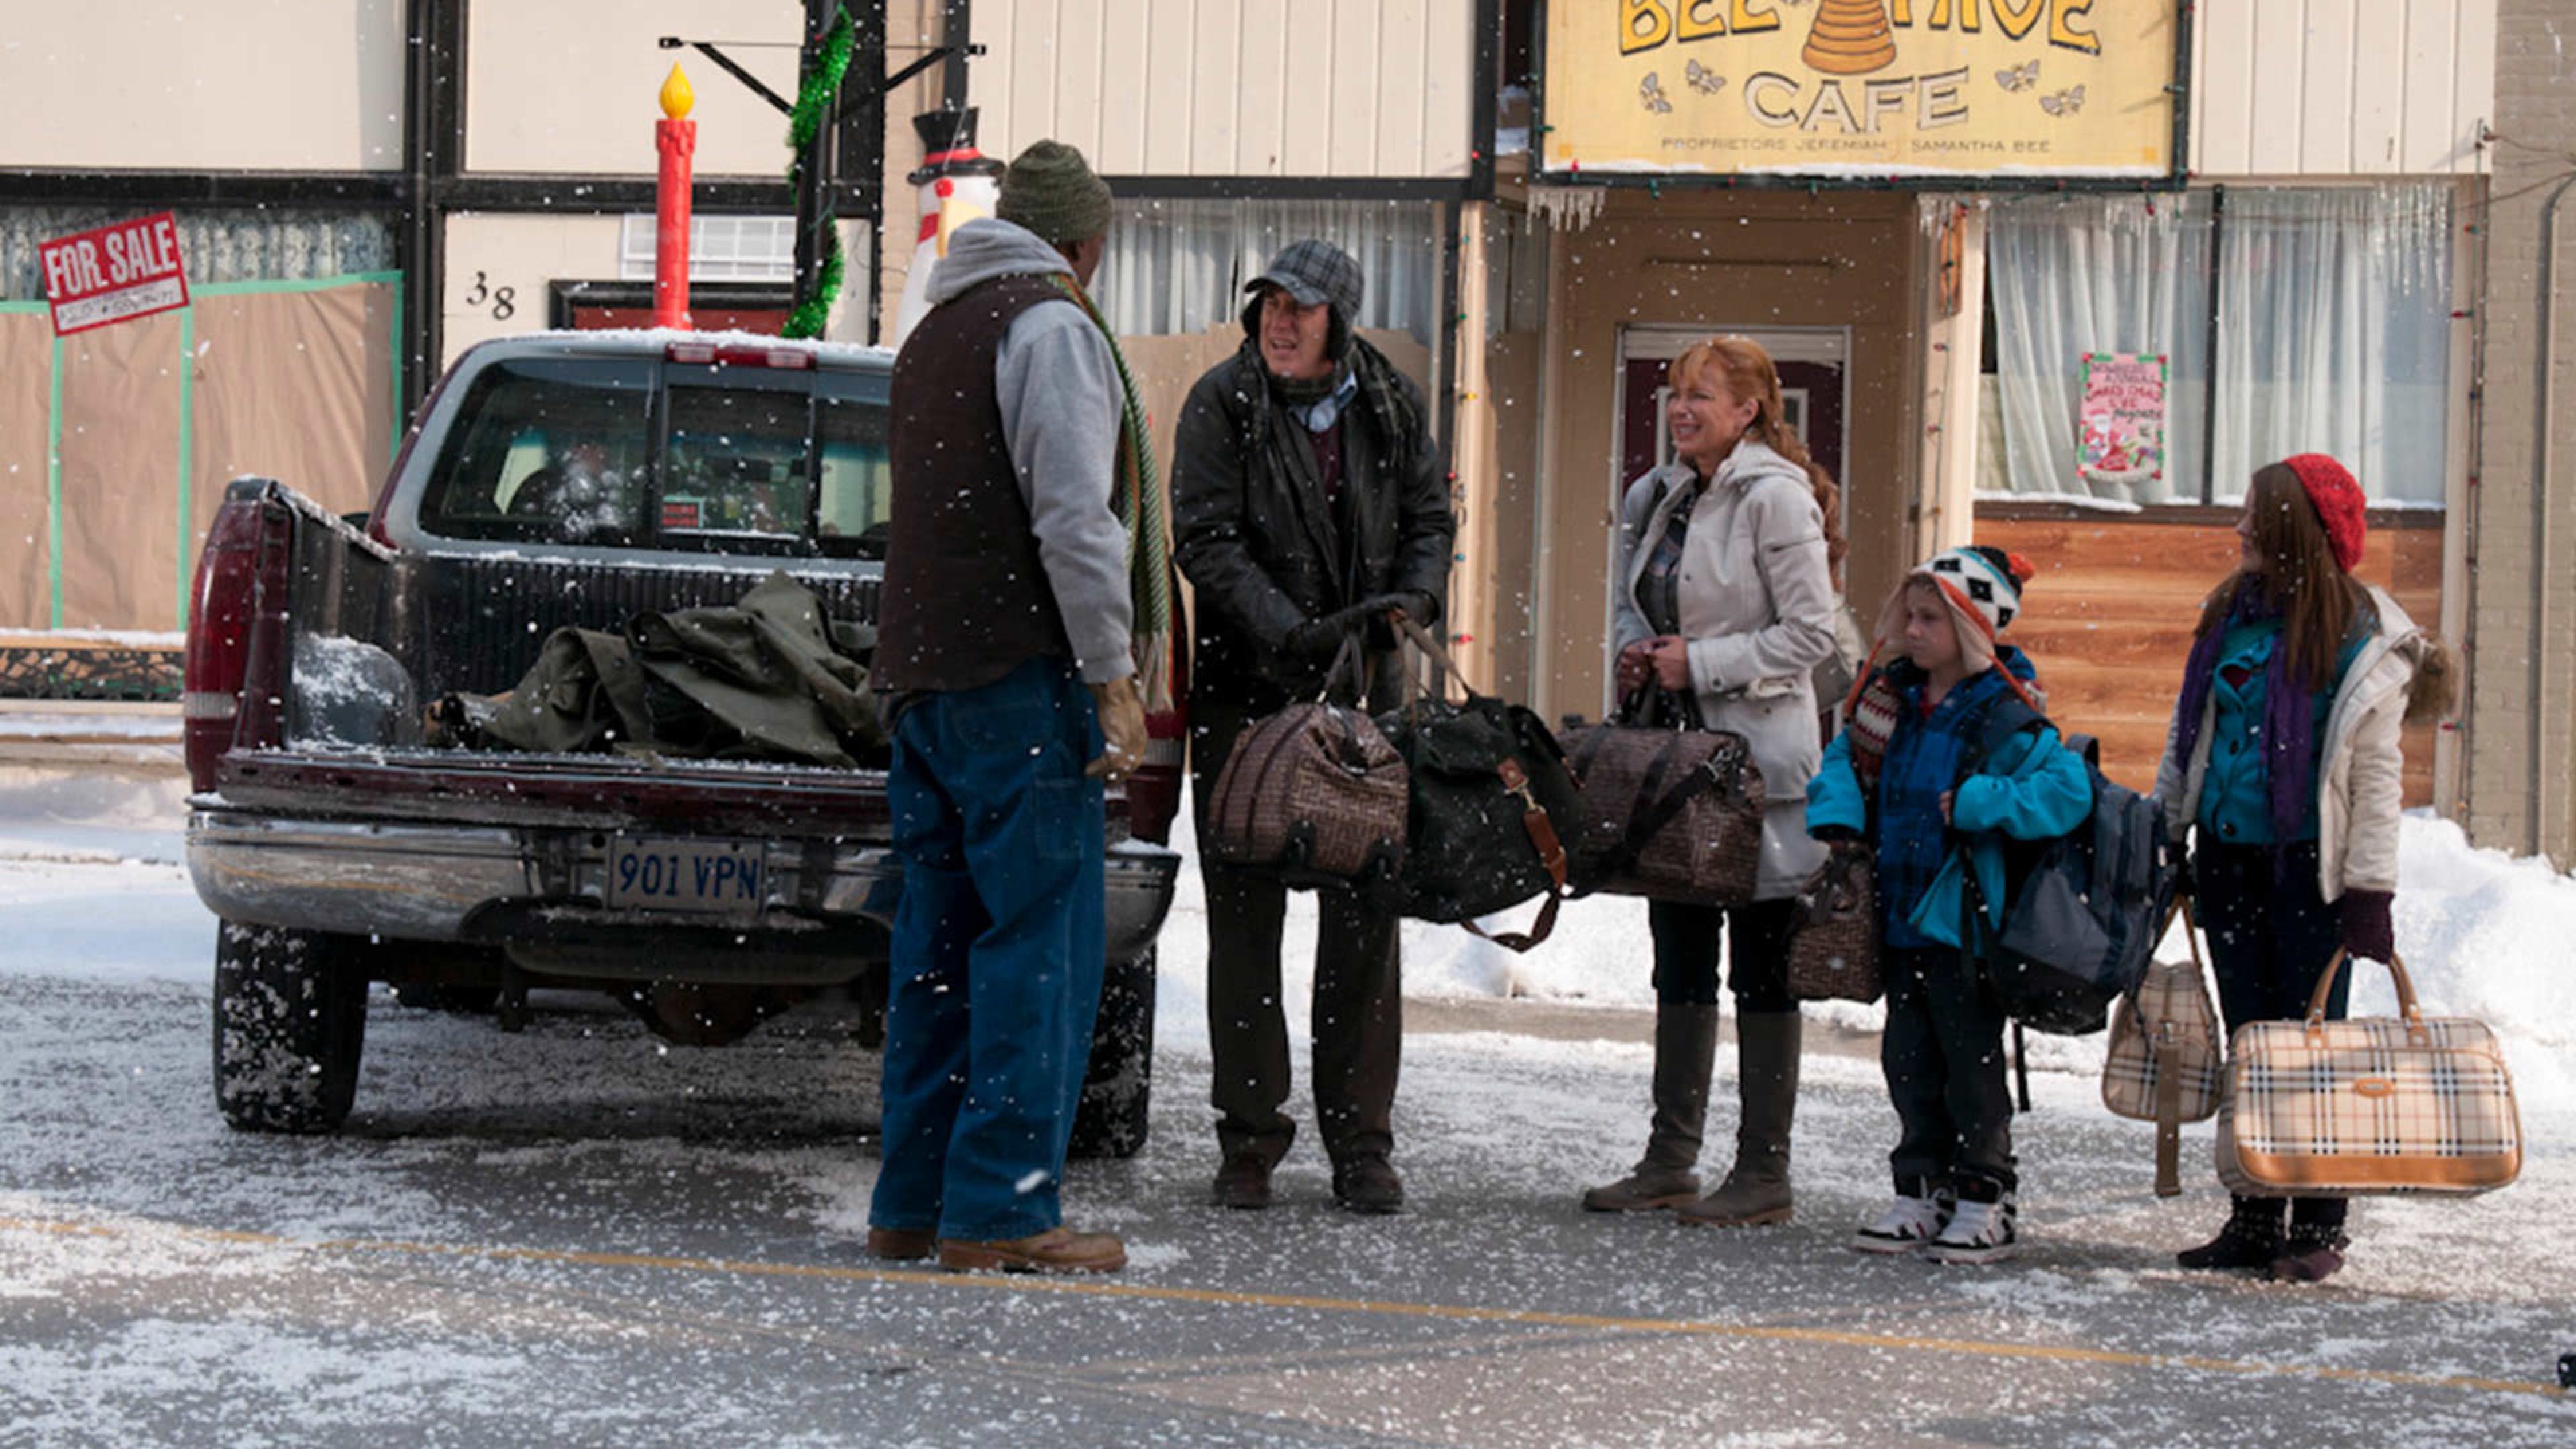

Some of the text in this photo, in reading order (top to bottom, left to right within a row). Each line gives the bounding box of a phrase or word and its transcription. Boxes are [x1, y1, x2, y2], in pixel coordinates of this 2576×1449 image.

[1743, 65, 1970, 133] CAFE
[1662, 137, 2051, 153] PROPRIETORS JEREMIAH SAMANTHA BEE
[44, 221, 177, 299] FOR SALE
[466, 270, 515, 321] 38
[619, 853, 759, 900] 901 VPN
